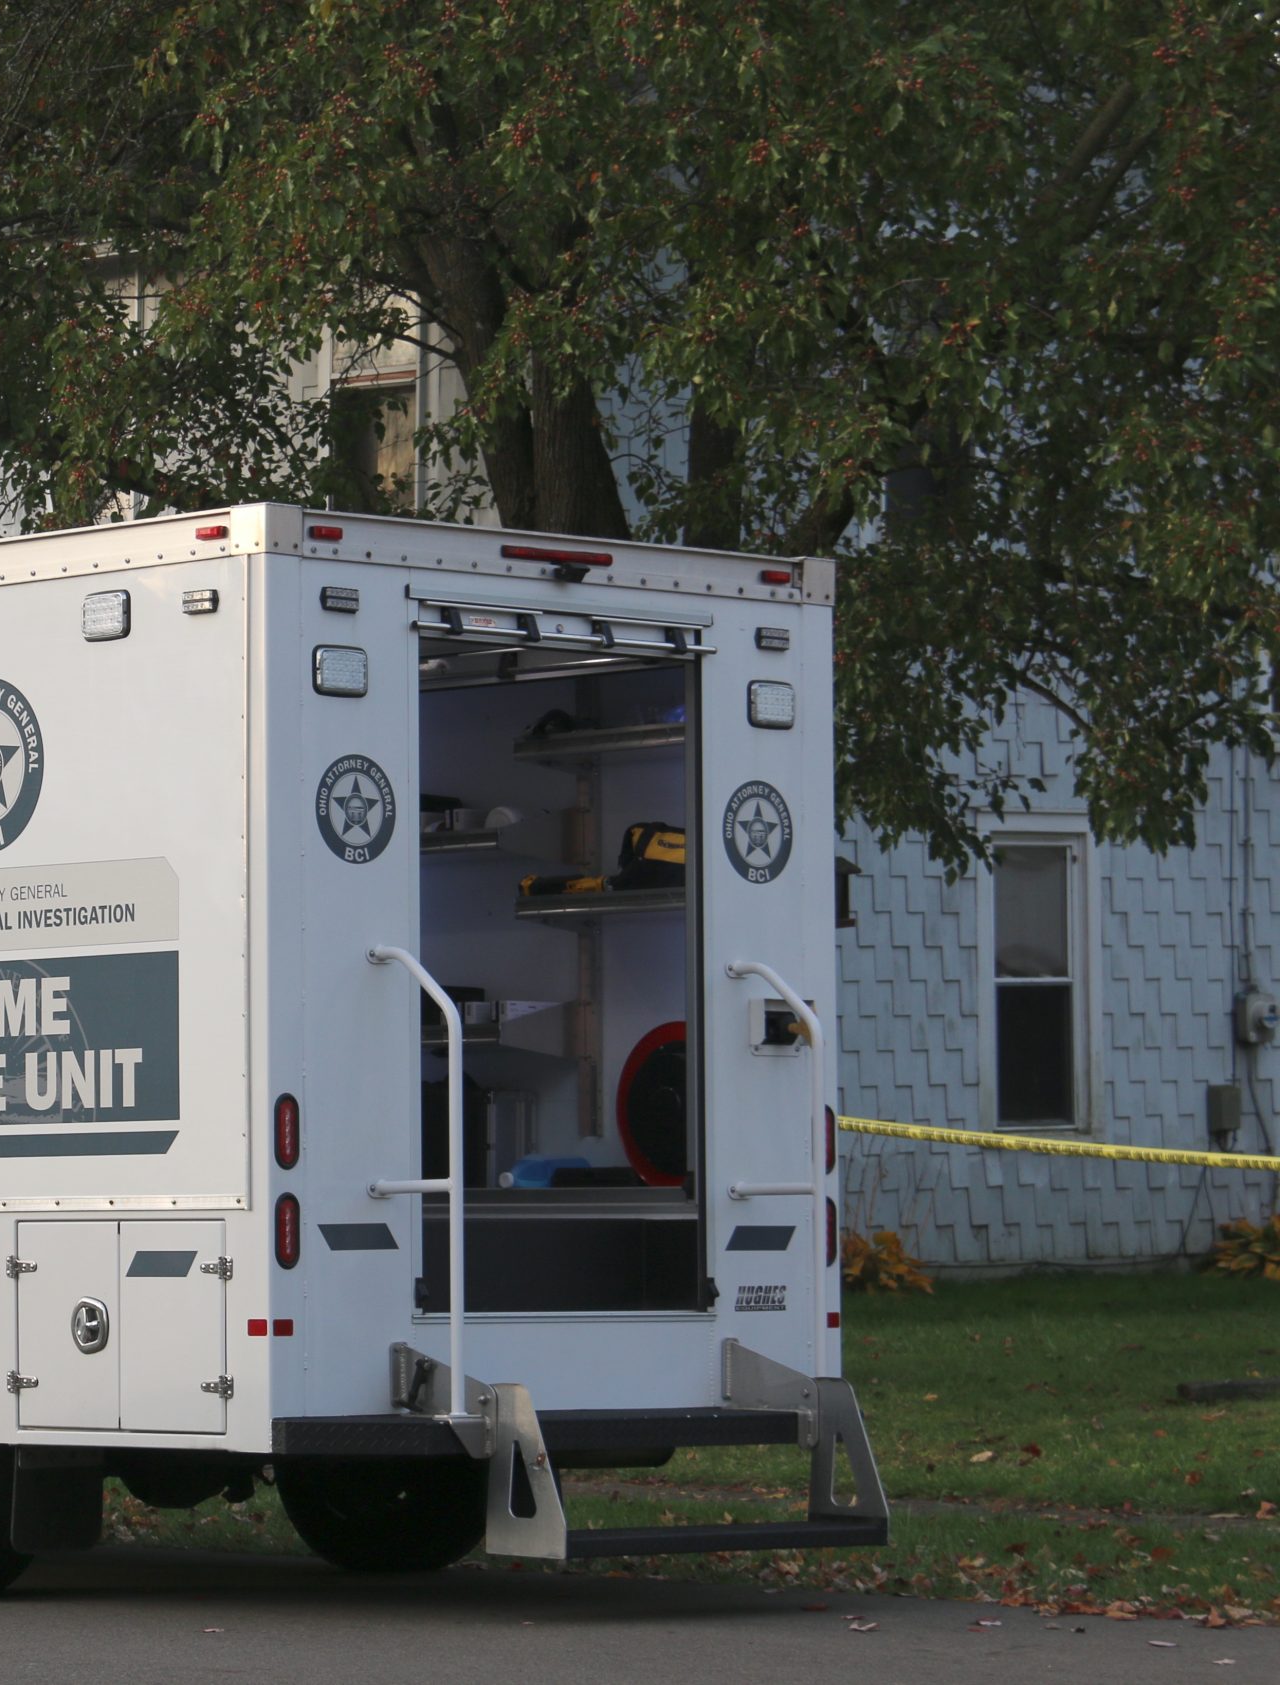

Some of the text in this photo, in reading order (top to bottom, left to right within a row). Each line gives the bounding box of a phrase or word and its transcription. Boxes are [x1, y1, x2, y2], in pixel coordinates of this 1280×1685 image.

[6, 694, 39, 773] GENERAL
[319, 759, 393, 818] OHIO ATTORNEY GENERAL
[725, 785, 791, 841] OHIO ATTORNEY GENERAL
[344, 847, 370, 862] BCI
[748, 868, 770, 882] BCI
[10, 883, 68, 901] GENERAL
[17, 903, 135, 930] INVESTIGATION
[24, 1047, 143, 1111] UNIT
